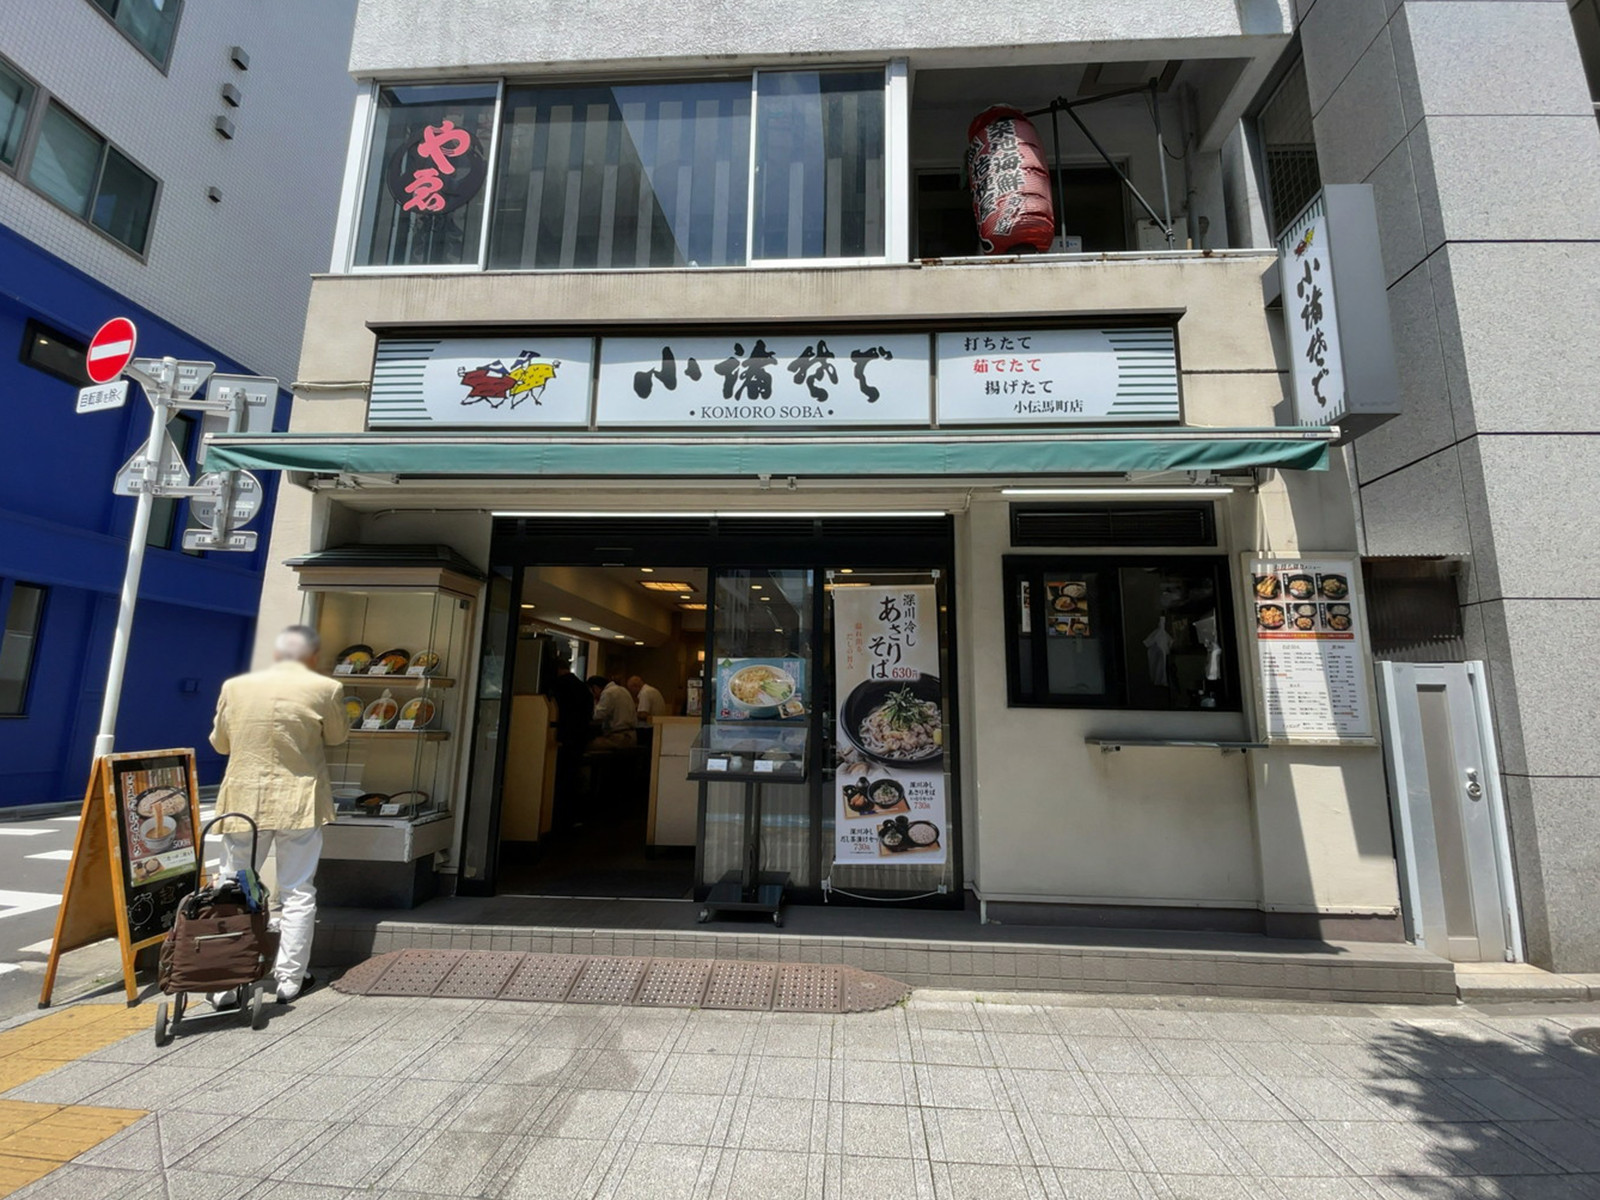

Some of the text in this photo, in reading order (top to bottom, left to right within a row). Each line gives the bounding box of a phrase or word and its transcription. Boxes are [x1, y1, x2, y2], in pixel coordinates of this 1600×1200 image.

[985, 118, 1025, 194] 築地海鮮
[964, 336, 1032, 352] 打ちたて
[973, 358, 1042, 374] 茹でたて
[985, 380, 1053, 395] 揚げたて
[701, 406, 823, 419] KOMORO SOBA
[1013, 399, 1083, 414] 小伝馬町店
[903, 593, 917, 647] 深川冷し
[878, 595, 902, 665] あさり
[868, 636, 890, 679] そば
[892, 667, 918, 679] 630円
[910, 781, 933, 789] 深川冷し
